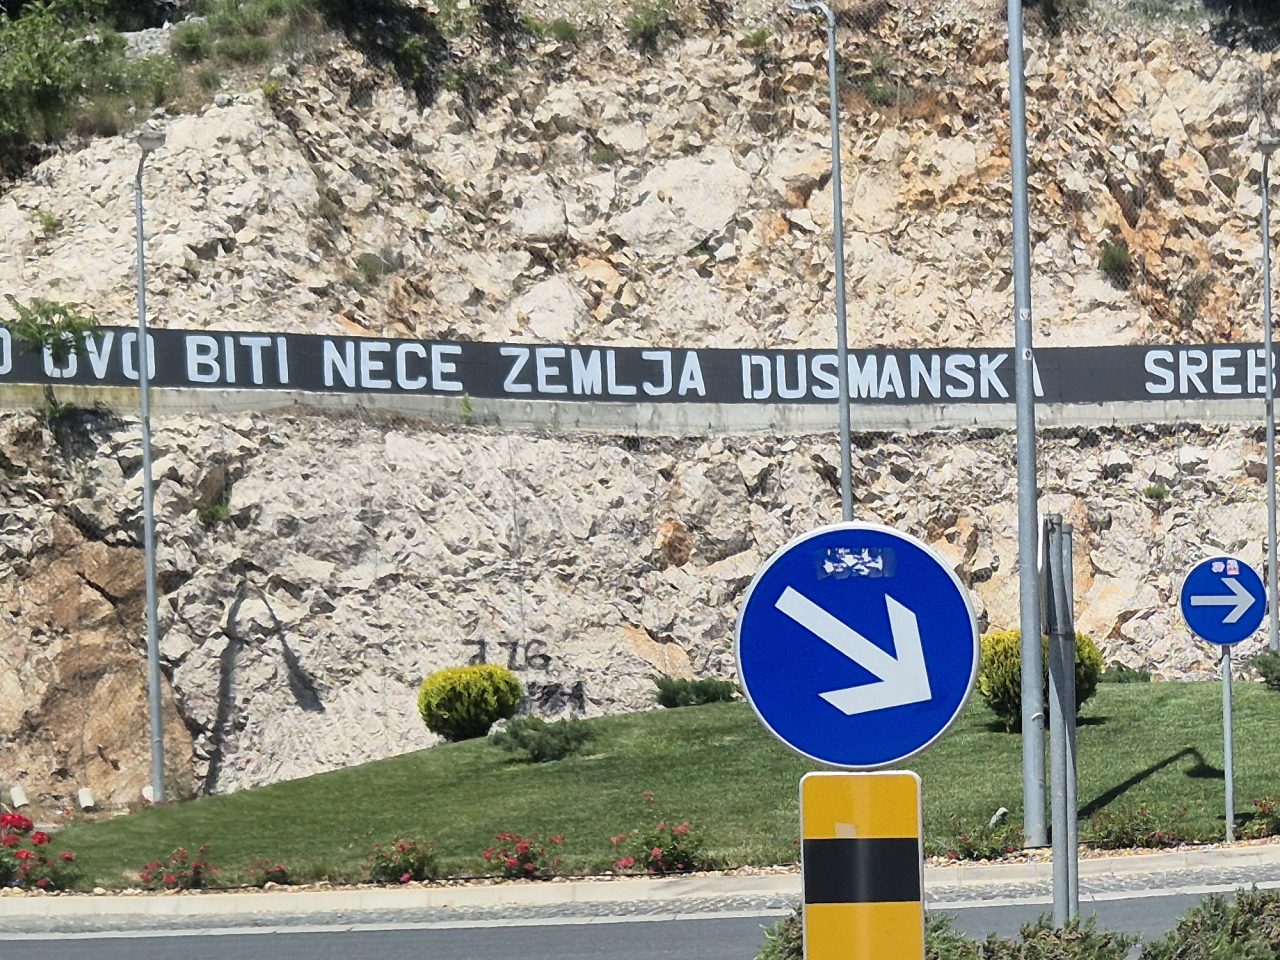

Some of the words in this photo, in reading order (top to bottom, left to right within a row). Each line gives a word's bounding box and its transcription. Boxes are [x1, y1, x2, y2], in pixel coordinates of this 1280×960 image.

[42, 330, 156, 381] OVO
[185, 335, 290, 385] BITI
[323, 340, 464, 391] NECE
[500, 347, 706, 397] ZEMLJA
